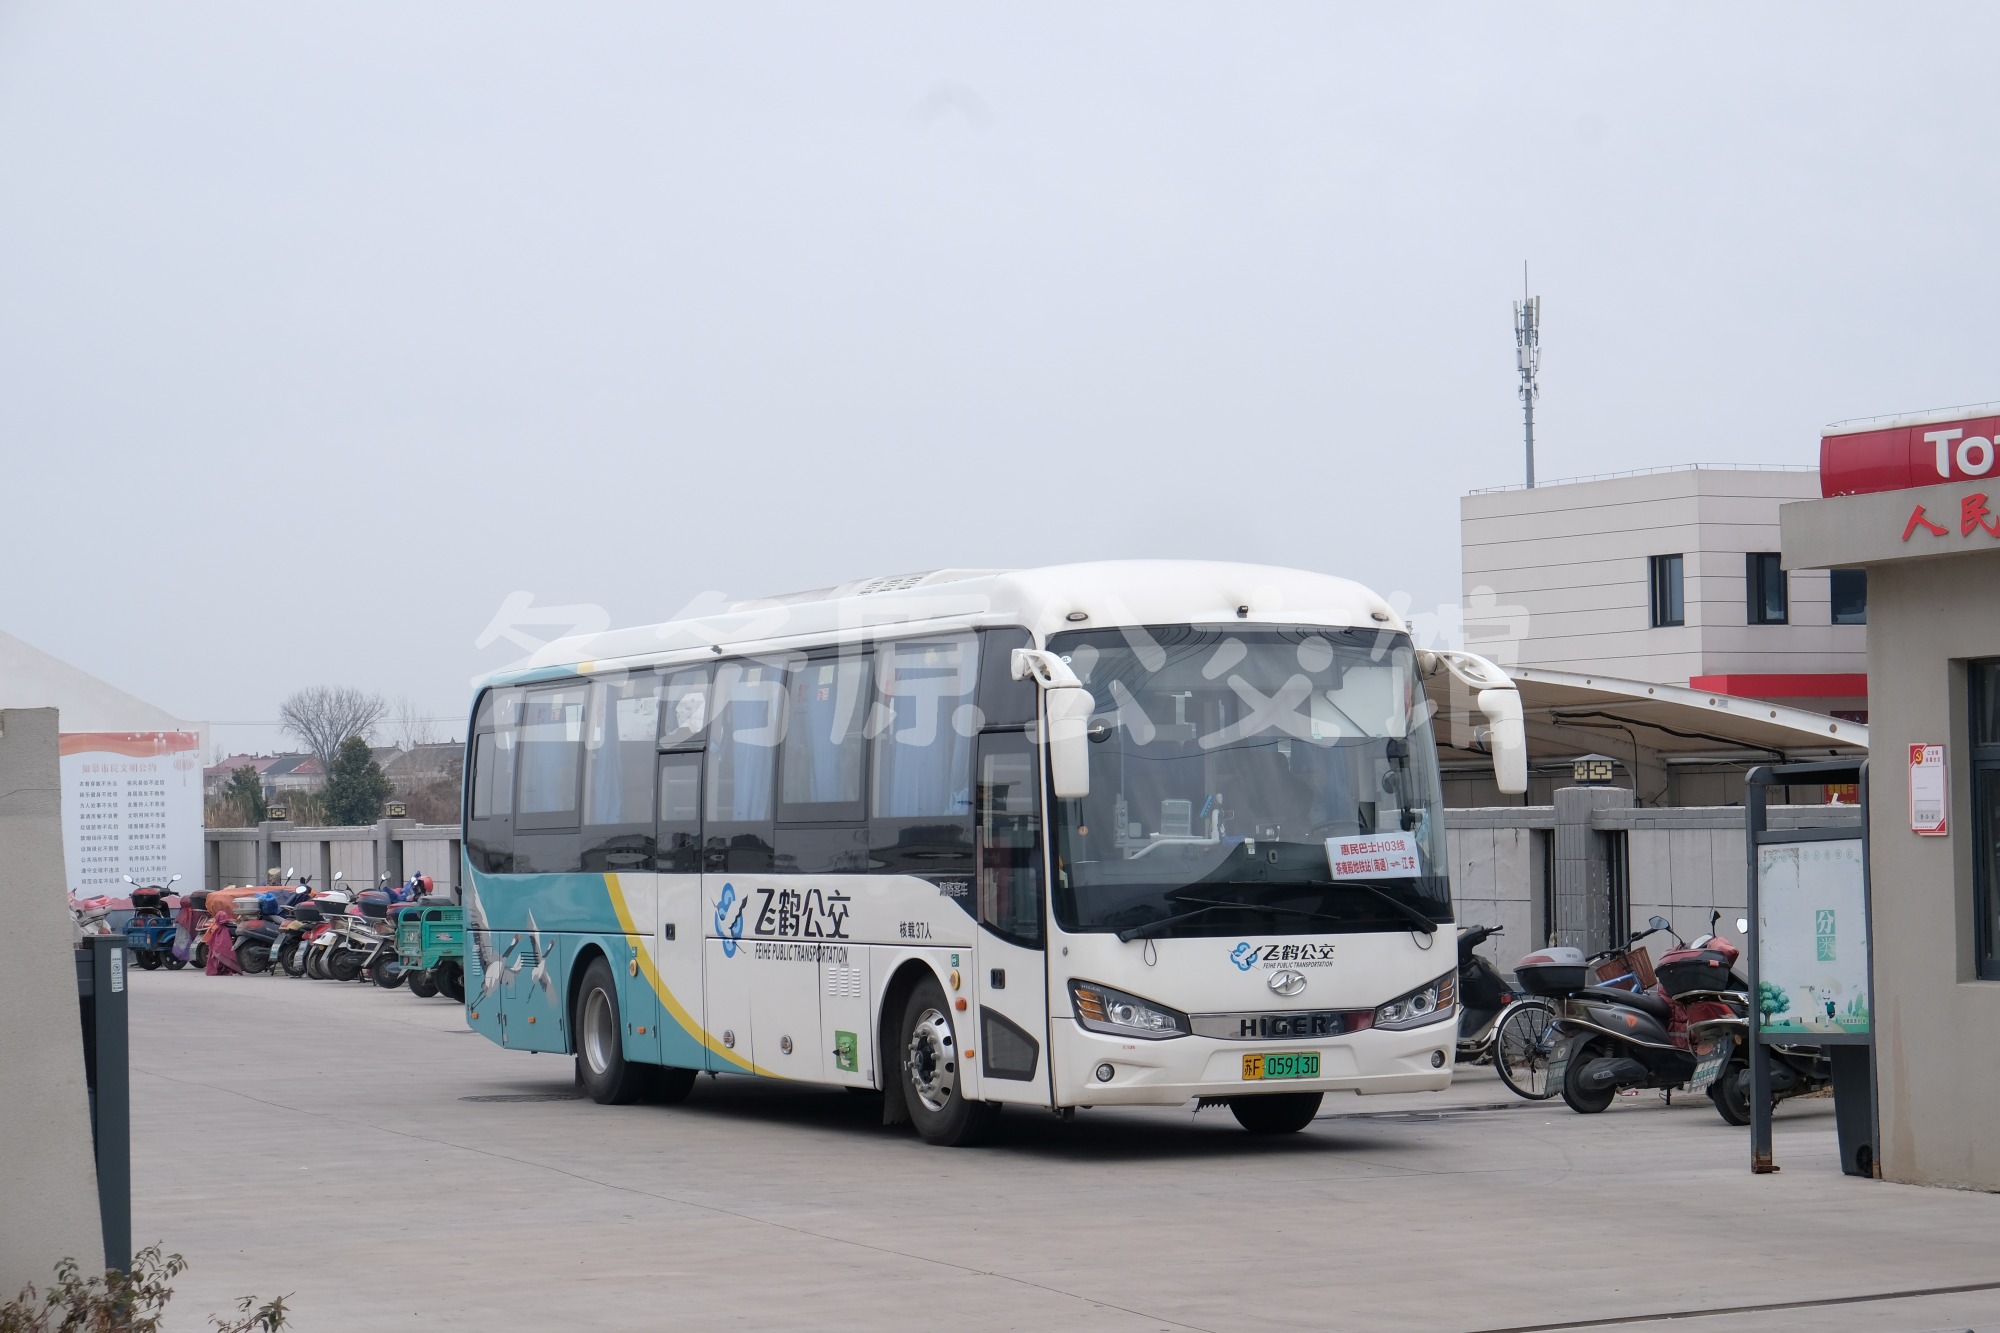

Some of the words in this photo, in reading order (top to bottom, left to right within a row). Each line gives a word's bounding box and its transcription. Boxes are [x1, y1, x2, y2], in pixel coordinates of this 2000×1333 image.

[1924, 428, 2000, 478] TO
[1901, 492, 2000, 542] 人民
[1340, 840, 1406, 856] 惠民巴士H03线
[1401, 856, 1415, 870] 江安
[755, 888, 850, 939] 飞鹤公交
[899, 921, 932, 939] 核载37人
[1816, 910, 1836, 960] 分类
[755, 943, 771, 959] FEIHE
[772, 944, 793, 960] PUBLIC
[794, 945, 849, 963] TRANSPORTATION
[1263, 944, 1335, 960] 飞鹤公交
[1240, 1016, 1327, 1037] HIGER
[1244, 1058, 1262, 1076] 苏F
[1268, 1056, 1319, 1075] 05913D
